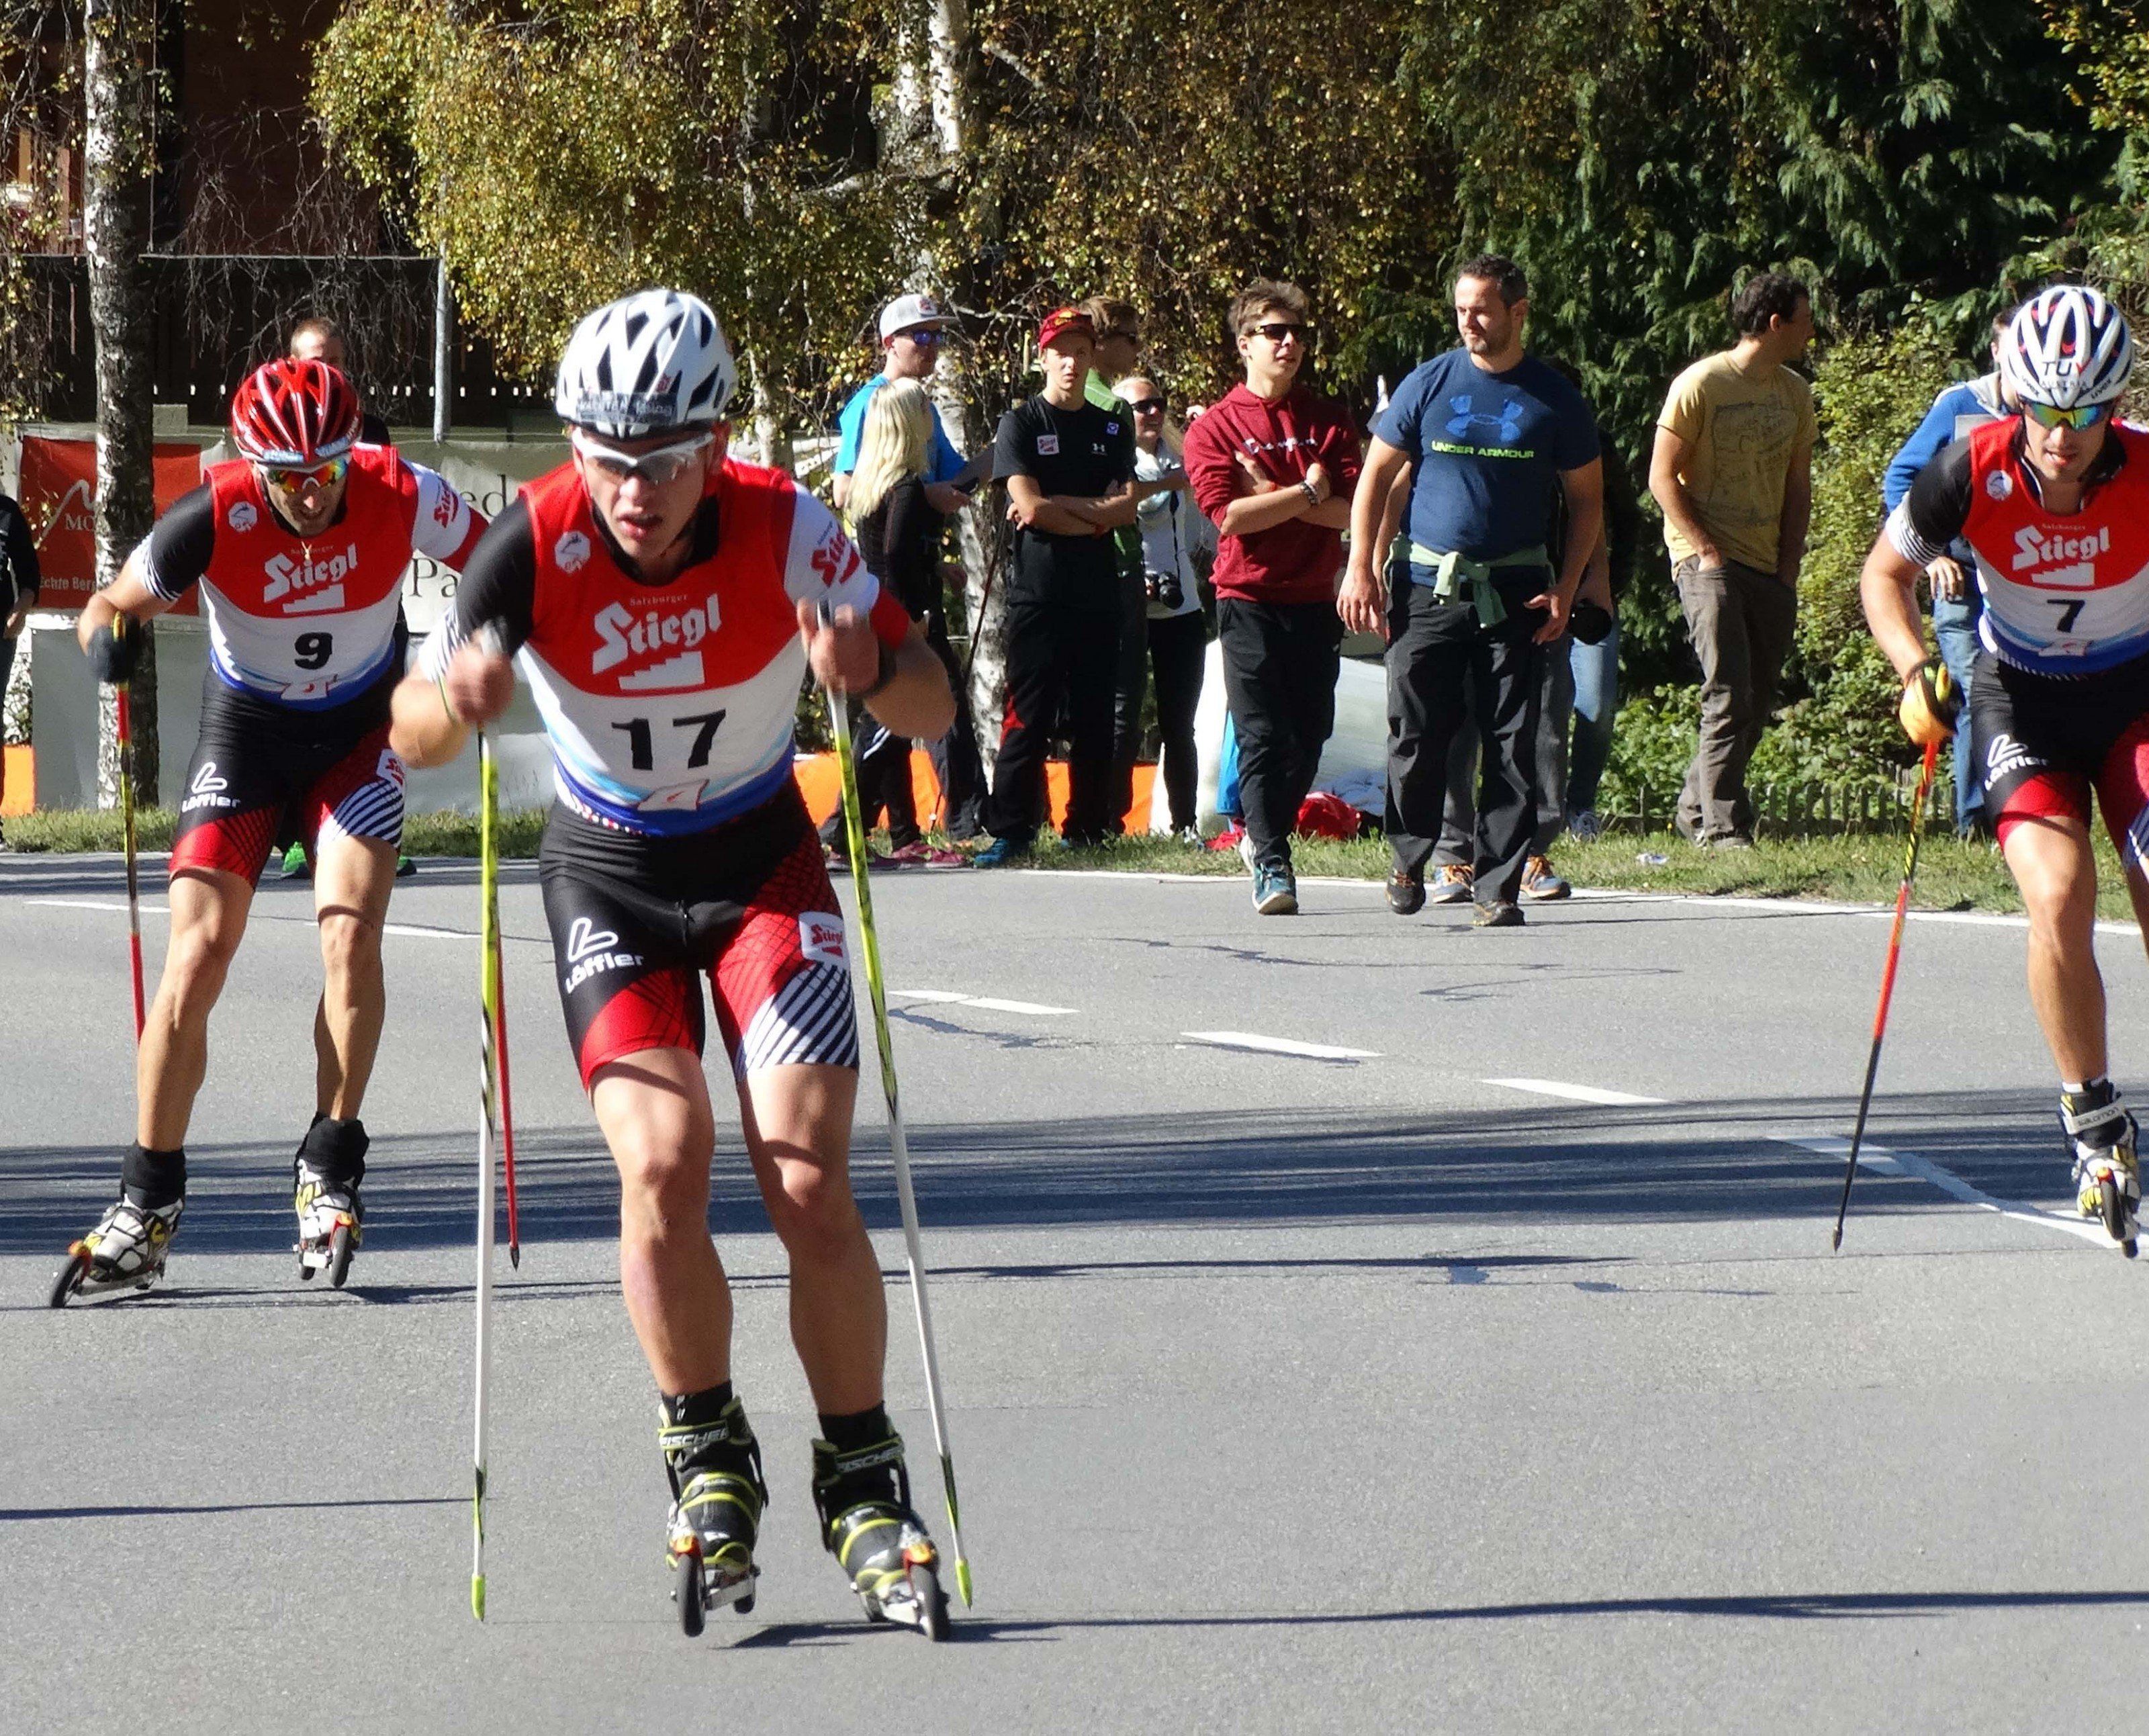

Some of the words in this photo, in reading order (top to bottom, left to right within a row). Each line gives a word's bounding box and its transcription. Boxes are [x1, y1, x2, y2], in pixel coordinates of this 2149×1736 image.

[1431, 440, 1474, 455] UNDER
[1477, 447, 1535, 459] ARMOUR
[2013, 524, 2110, 571] Stiegl
[264, 543, 357, 603] Stiegl
[630, 594, 688, 606] Salzburger
[2047, 599, 2085, 633] 7
[294, 632, 333, 670] 9
[592, 593, 722, 674] Stiegl
[611, 709, 726, 770] 17
